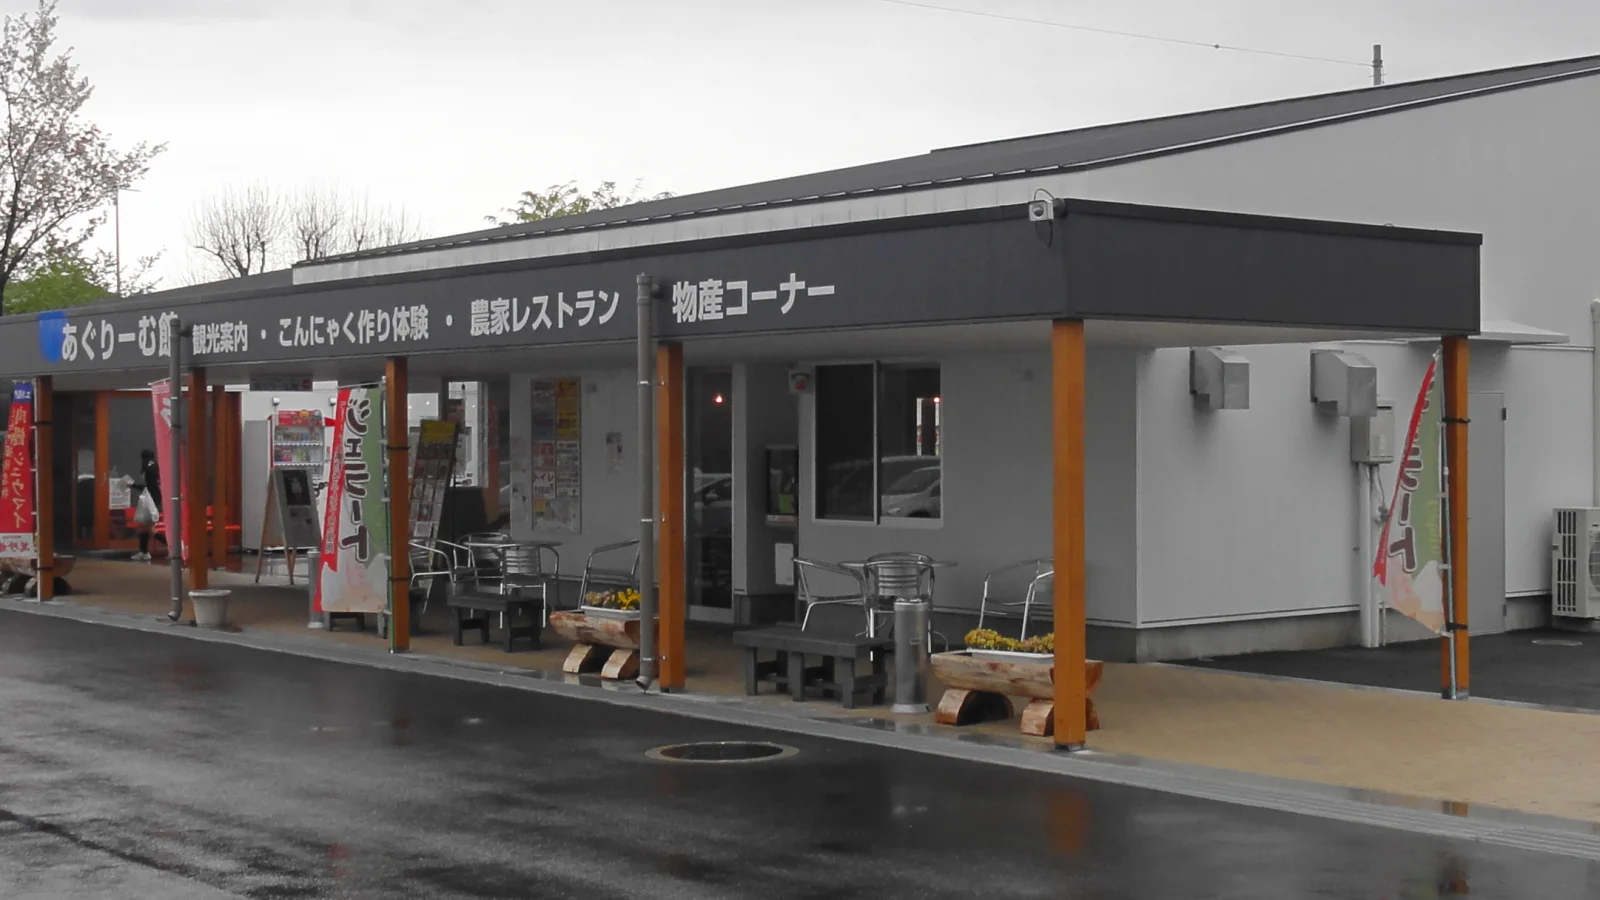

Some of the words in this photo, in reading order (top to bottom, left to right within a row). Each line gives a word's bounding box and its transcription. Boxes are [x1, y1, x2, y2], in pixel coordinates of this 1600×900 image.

[192, 320, 248, 355] 観光案内
[279, 304, 429, 346] こんにゃく作り体験
[470, 290, 620, 336] 農家レストラン
[672, 273, 835, 323] 物産コーナー
